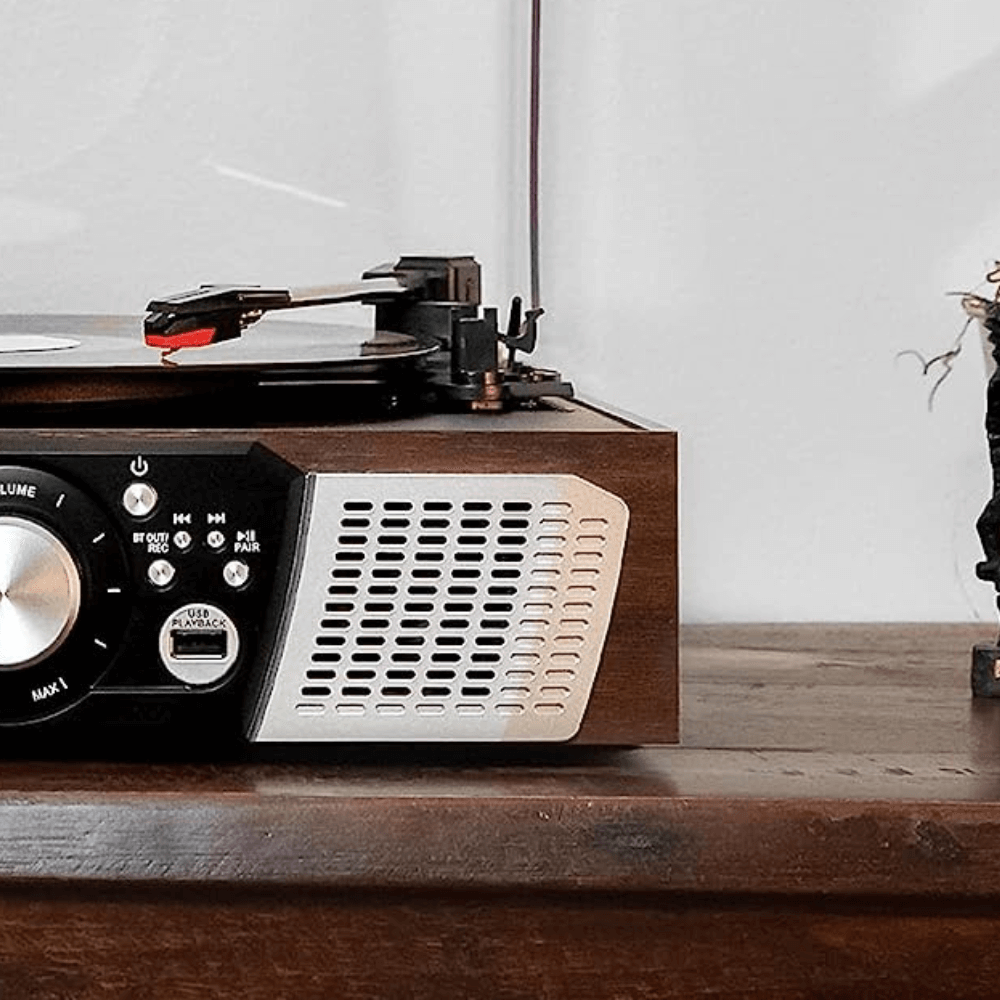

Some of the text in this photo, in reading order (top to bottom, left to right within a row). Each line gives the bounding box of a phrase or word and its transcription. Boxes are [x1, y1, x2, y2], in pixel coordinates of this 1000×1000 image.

[132, 532, 144, 543] BT
[147, 543, 169, 553] REC
[233, 542, 261, 553] PAIR
[187, 609, 210, 618] USB
[171, 618, 227, 628] PLAYBACK
[31, 681, 60, 702] MAX
